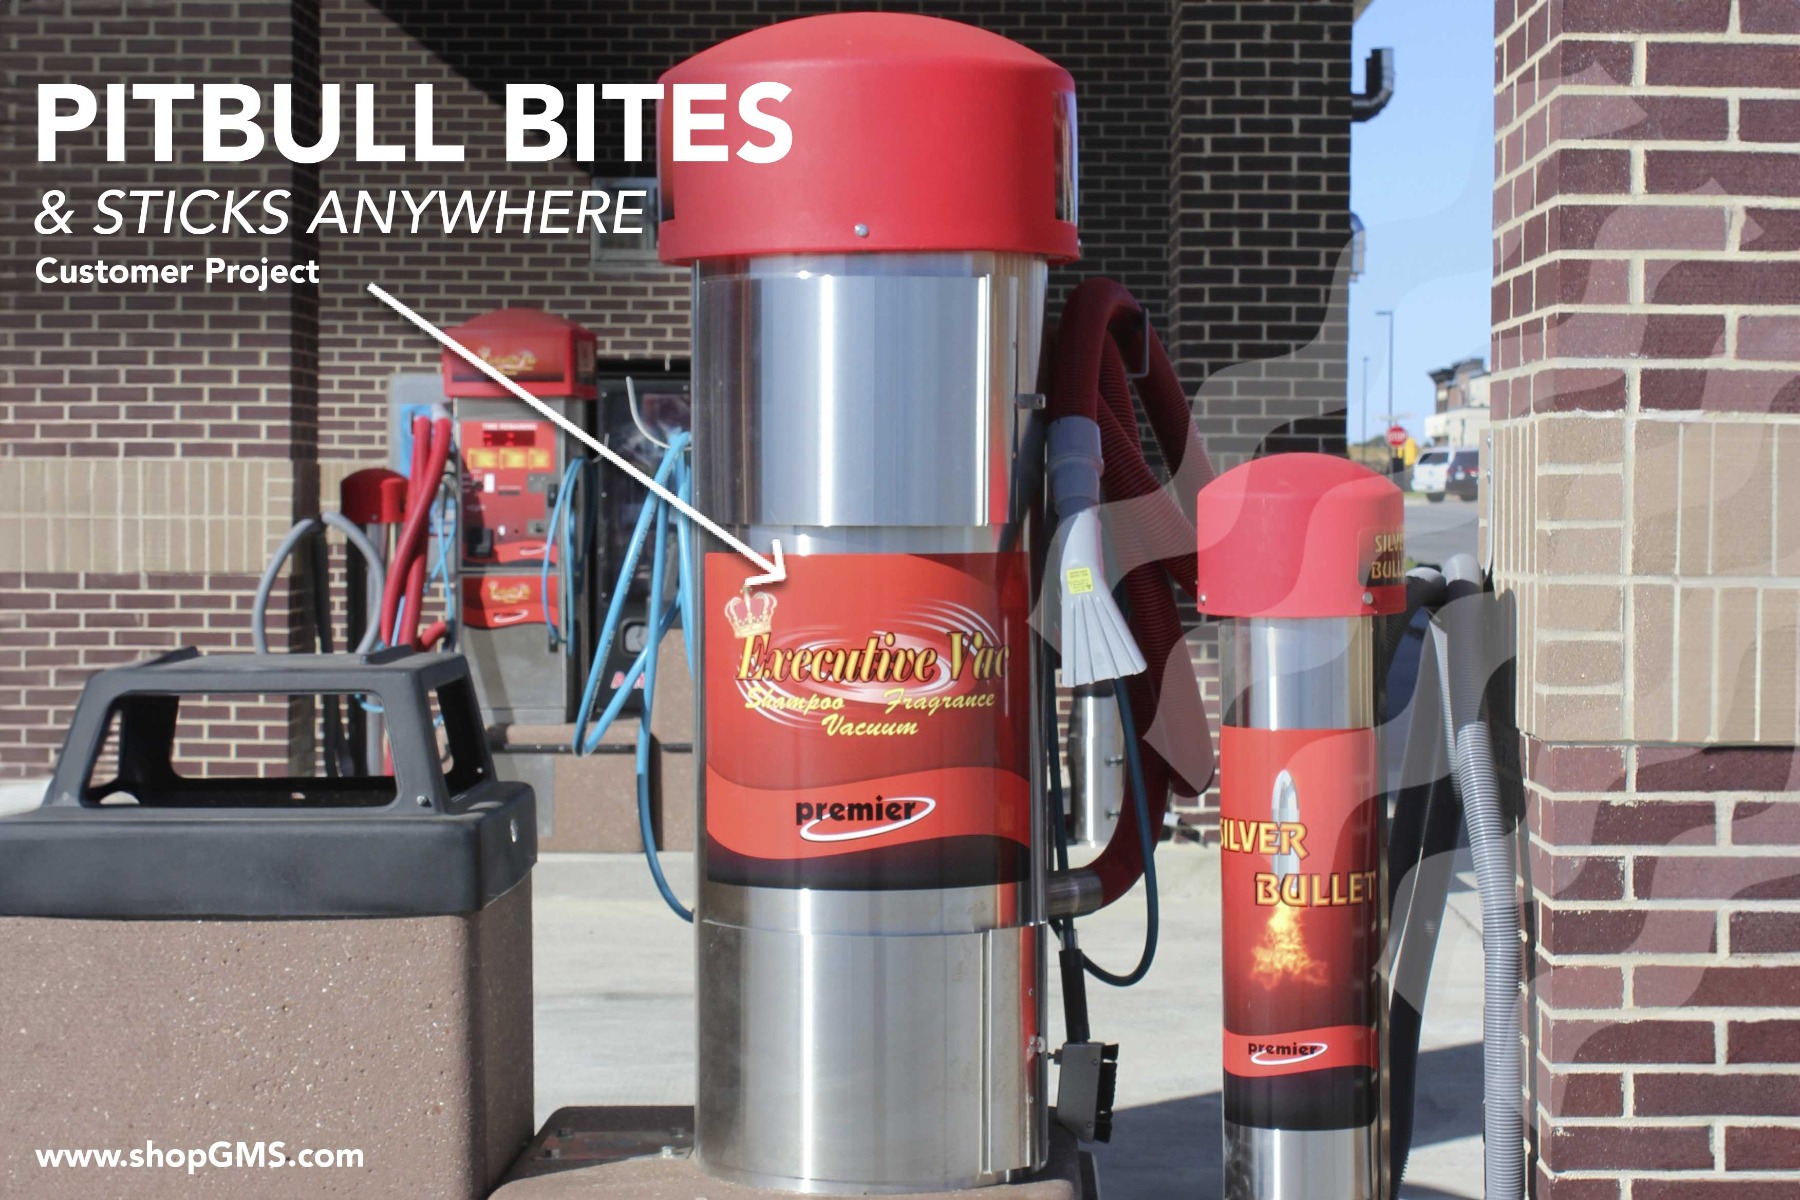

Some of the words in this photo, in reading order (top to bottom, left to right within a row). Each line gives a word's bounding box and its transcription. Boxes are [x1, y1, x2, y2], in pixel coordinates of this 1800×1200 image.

[1387, 431, 1406, 441] STOP
[735, 631, 938, 683] Executive
[947, 630, 1010, 681] Vac
[745, 685, 845, 715] Shampoo
[883, 687, 995, 716] Fragrance
[820, 713, 919, 737] Vacuum
[795, 794, 916, 826] premier
[1254, 870, 1376, 907] BULLET
[1248, 1042, 1318, 1056] premier
